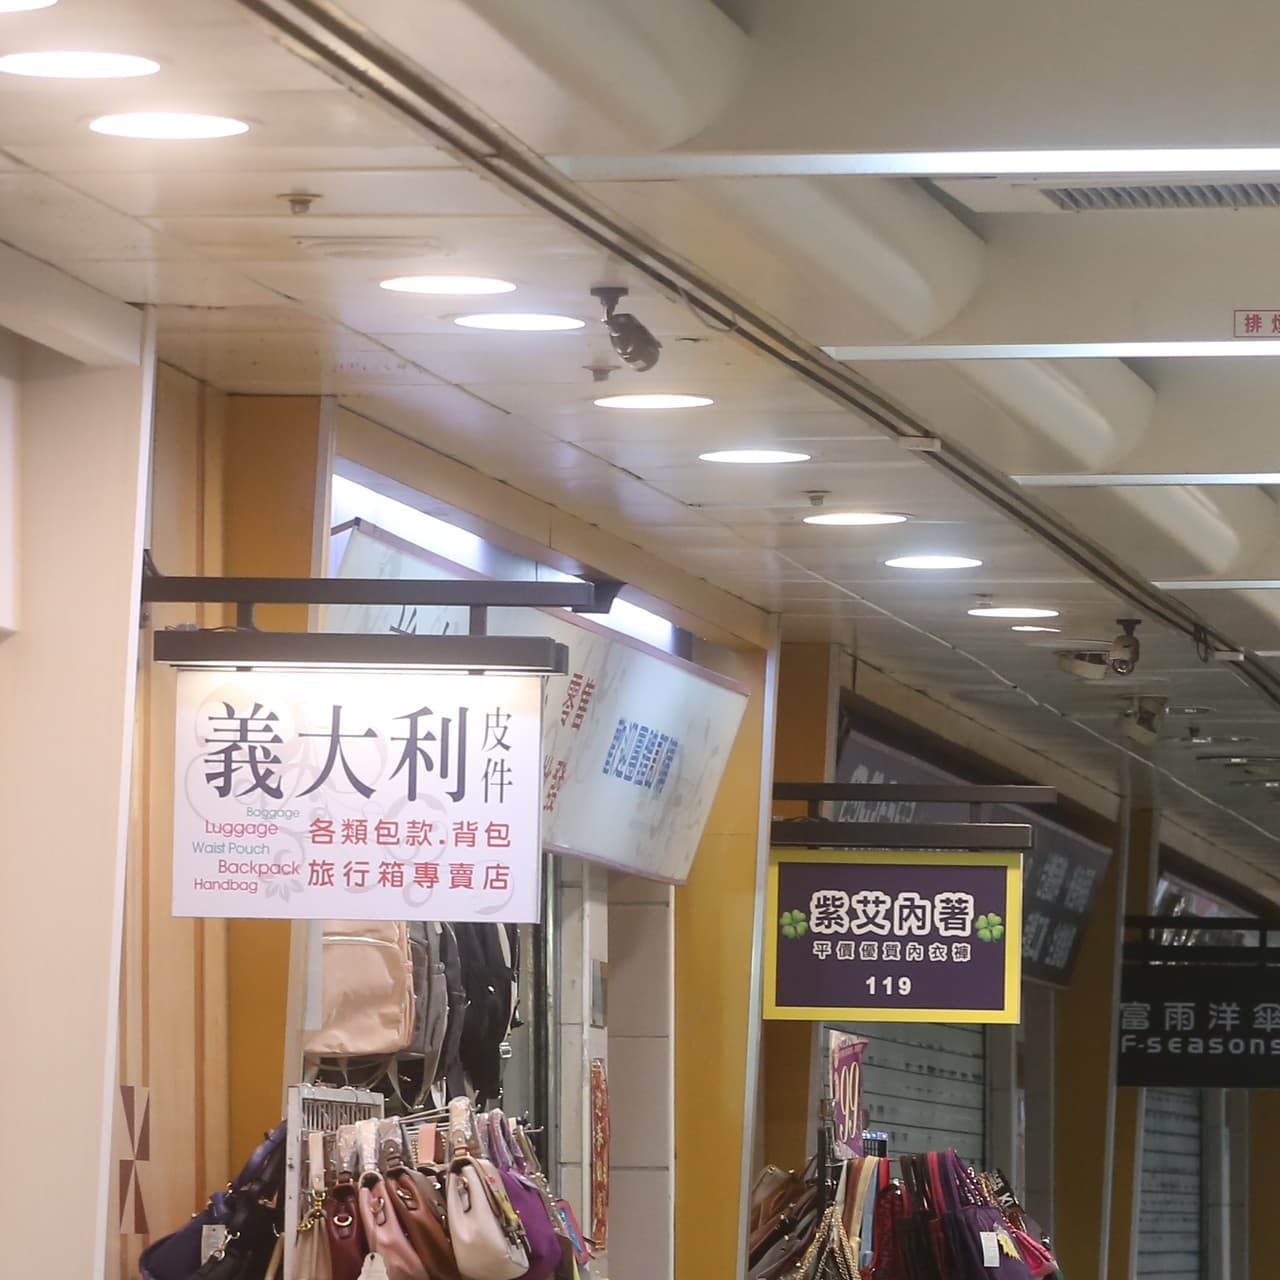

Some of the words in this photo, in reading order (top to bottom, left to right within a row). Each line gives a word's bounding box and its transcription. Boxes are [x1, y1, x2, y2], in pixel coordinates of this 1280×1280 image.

[203, 701, 467, 804] 義大利
[481, 707, 514, 804] 皮件
[246, 806, 300, 820] Baggage
[205, 820, 279, 838] Luggage
[192, 841, 226, 854] Waist
[228, 842, 270, 855] Pouch
[218, 859, 300, 877] Backpack
[307, 858, 511, 891] 旅行箱專賣店
[194, 878, 258, 894] Handbag
[813, 941, 971, 962] 平價優質內衣褲
[865, 976, 912, 995] 119
